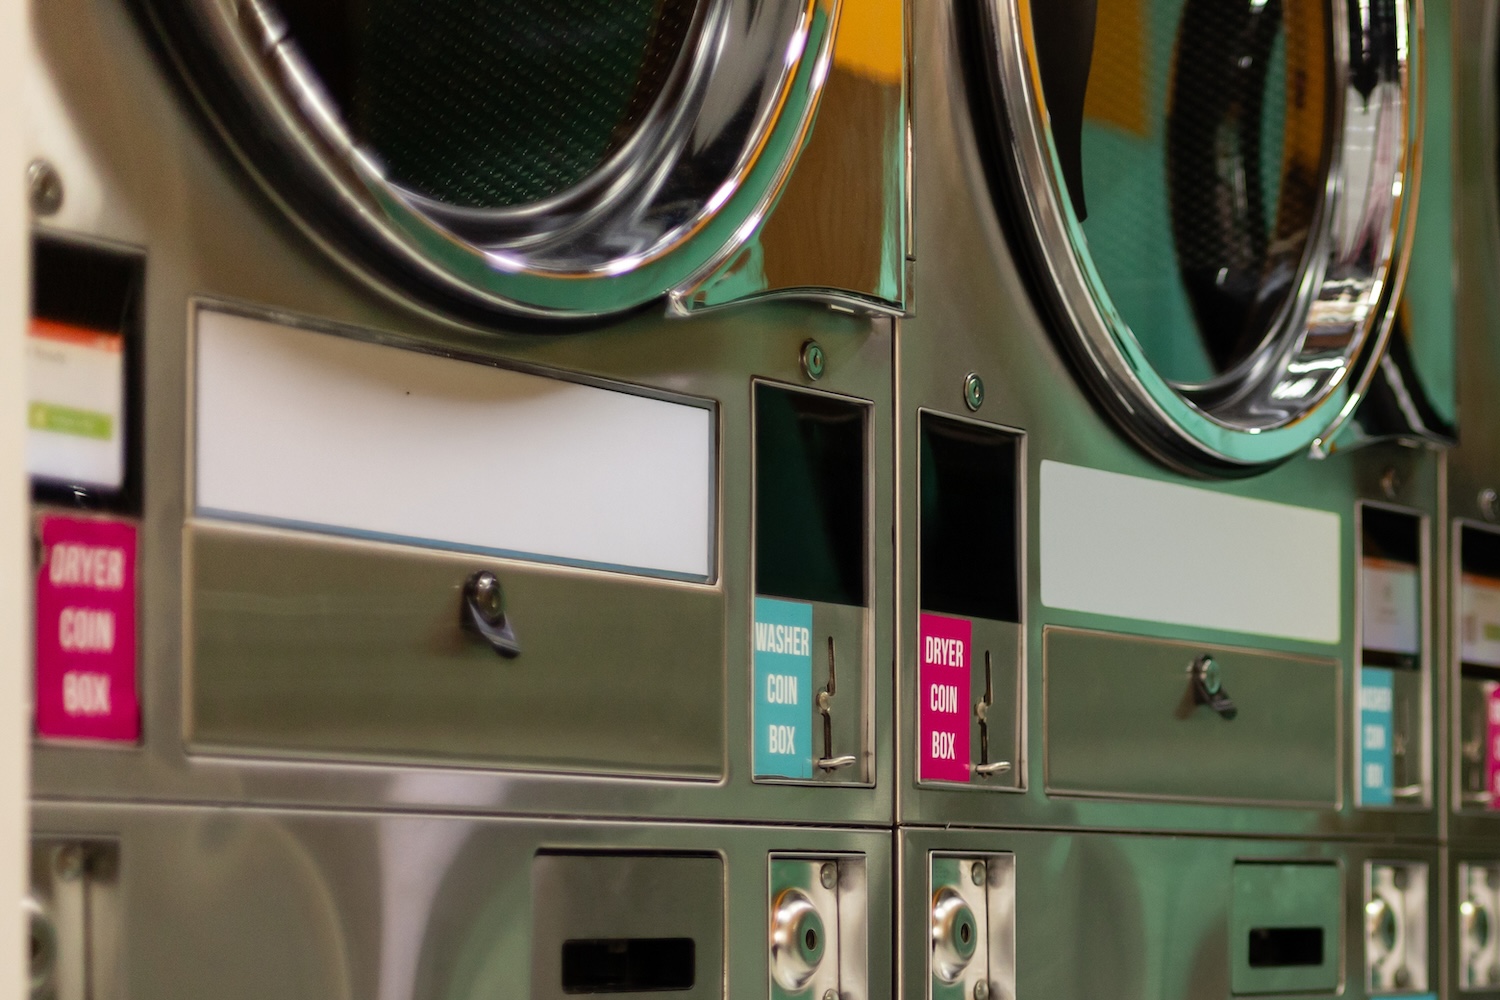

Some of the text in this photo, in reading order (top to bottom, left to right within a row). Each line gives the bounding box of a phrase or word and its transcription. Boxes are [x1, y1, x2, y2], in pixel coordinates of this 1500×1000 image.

[49, 542, 124, 591] DRYER
[59, 606, 115, 652] COIN
[755, 621, 810, 656] WASHER
[925, 635, 964, 667] DRYER
[62, 671, 111, 717] BOX
[767, 673, 798, 705] COIN
[930, 683, 958, 714] COIN
[769, 724, 796, 755] BOX
[931, 730, 956, 760] BOX
